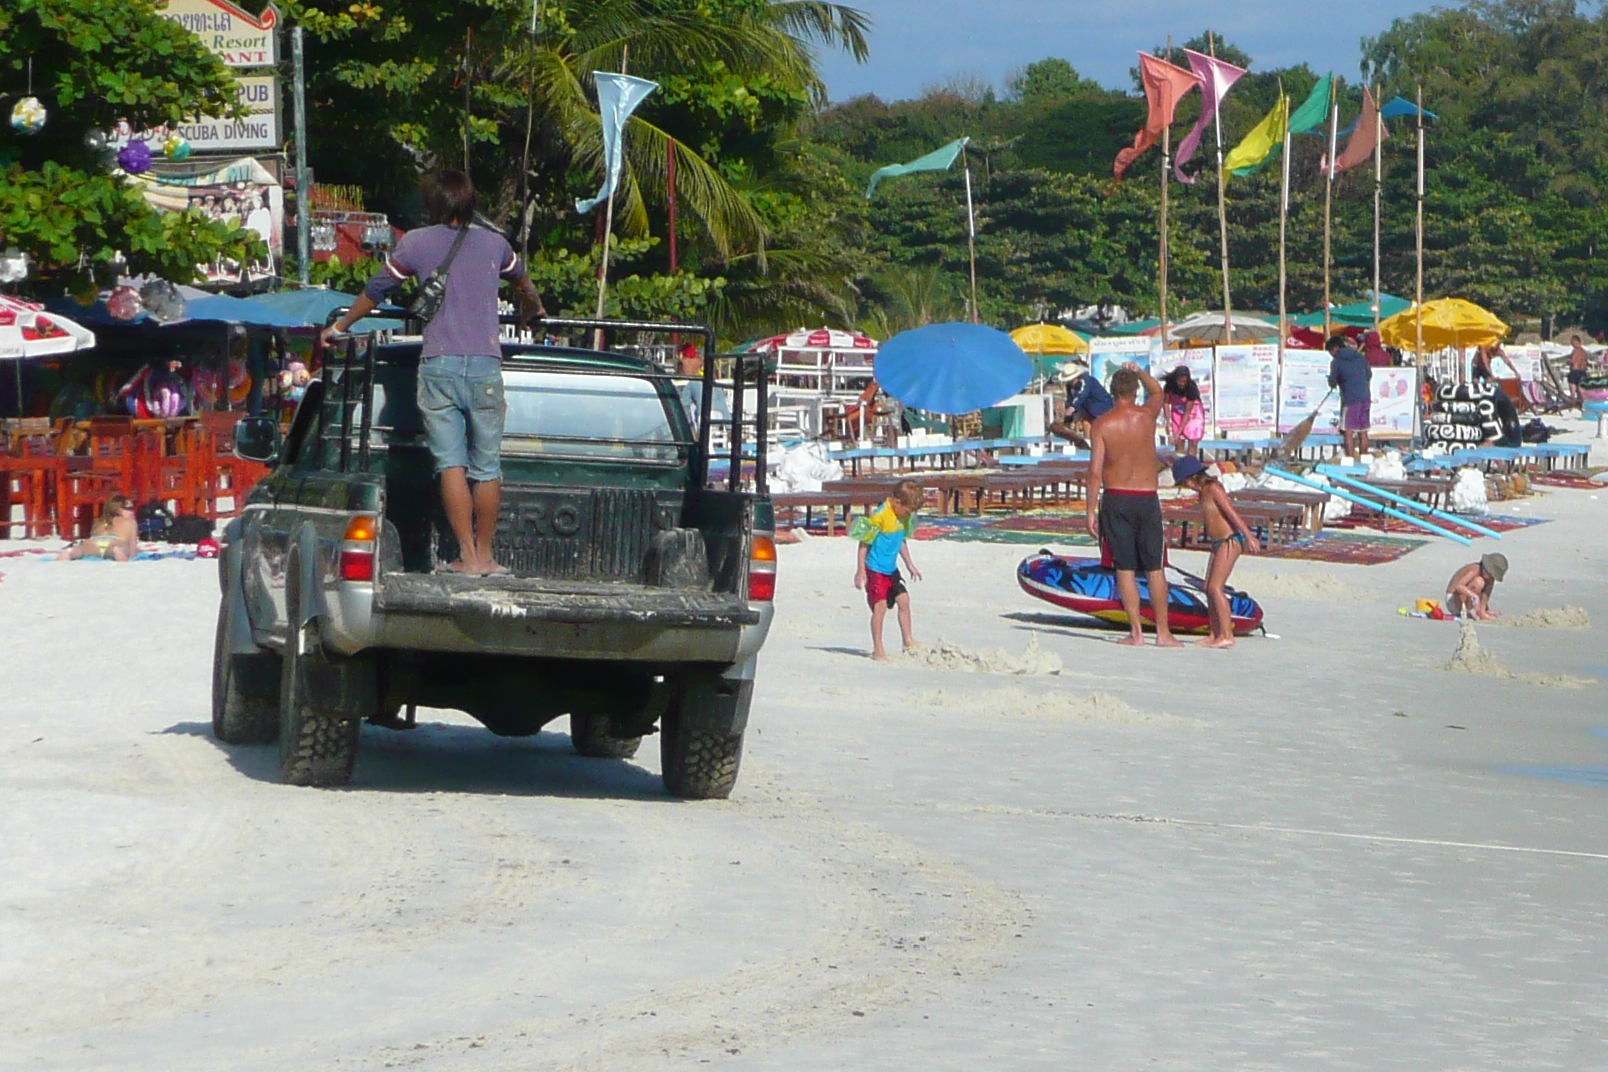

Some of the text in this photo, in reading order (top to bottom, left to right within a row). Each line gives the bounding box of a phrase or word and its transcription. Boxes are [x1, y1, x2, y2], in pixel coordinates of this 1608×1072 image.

[212, 34, 267, 50] Resort
[237, 84, 269, 104] PUB
[178, 124, 219, 141] SCUBA
[224, 122, 268, 140] DIVING
